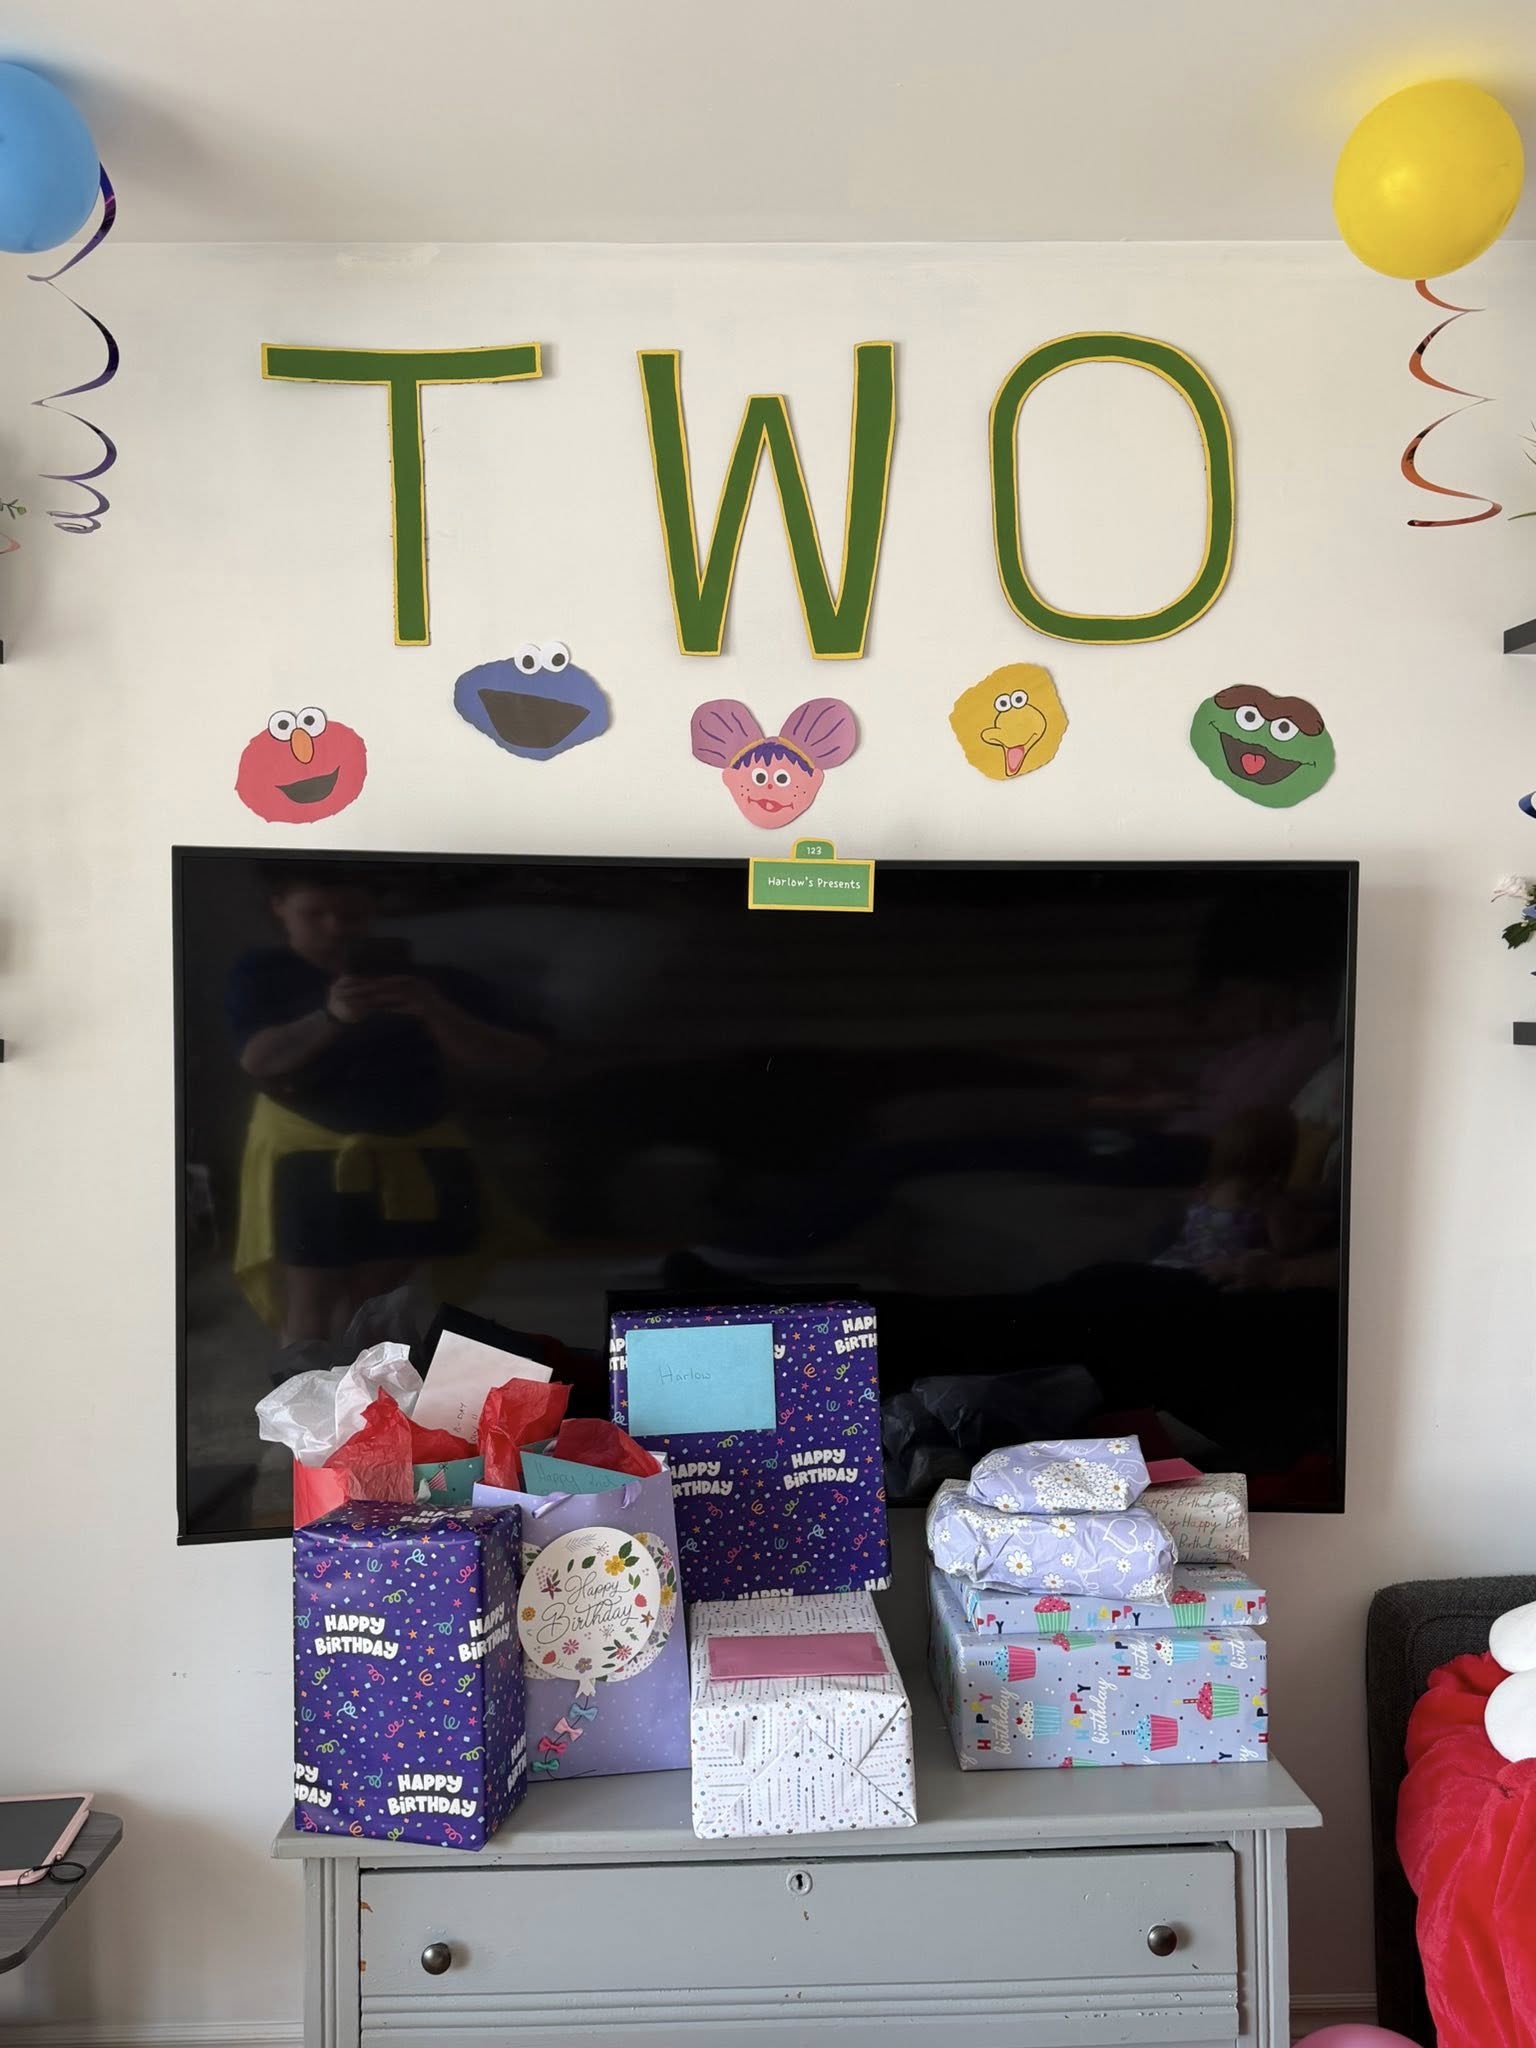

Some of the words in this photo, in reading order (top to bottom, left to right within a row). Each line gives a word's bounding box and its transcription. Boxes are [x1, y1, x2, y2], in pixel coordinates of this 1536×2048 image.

[261, 331, 1236, 661] TWO
[806, 846, 822, 855] 123
[768, 876, 814, 888] Harlow's
[817, 878, 861, 889] Presents
[842, 1316, 877, 1334] HAP
[660, 1363, 712, 1385] Harlow
[791, 1449, 846, 1469] HAPPY
[673, 1480, 733, 1498] RTHDAY
[1182, 1512, 1221, 1531] Happy
[564, 1571, 630, 1604] Happy
[1087, 1605, 1141, 1627] HAPPY
[1222, 1595, 1267, 1618] HAPP
[324, 1614, 386, 1635] HAPPY
[469, 1601, 505, 1638] HAPPY
[536, 1595, 638, 1645] Birthday
[976, 1613, 1005, 1635] PPY
[987, 1686, 1020, 1754] birthday
[1068, 1683, 1092, 1742] HAPPY
[1091, 1676, 1118, 1745] birthday
[397, 1774, 463, 1794] HAPPY
